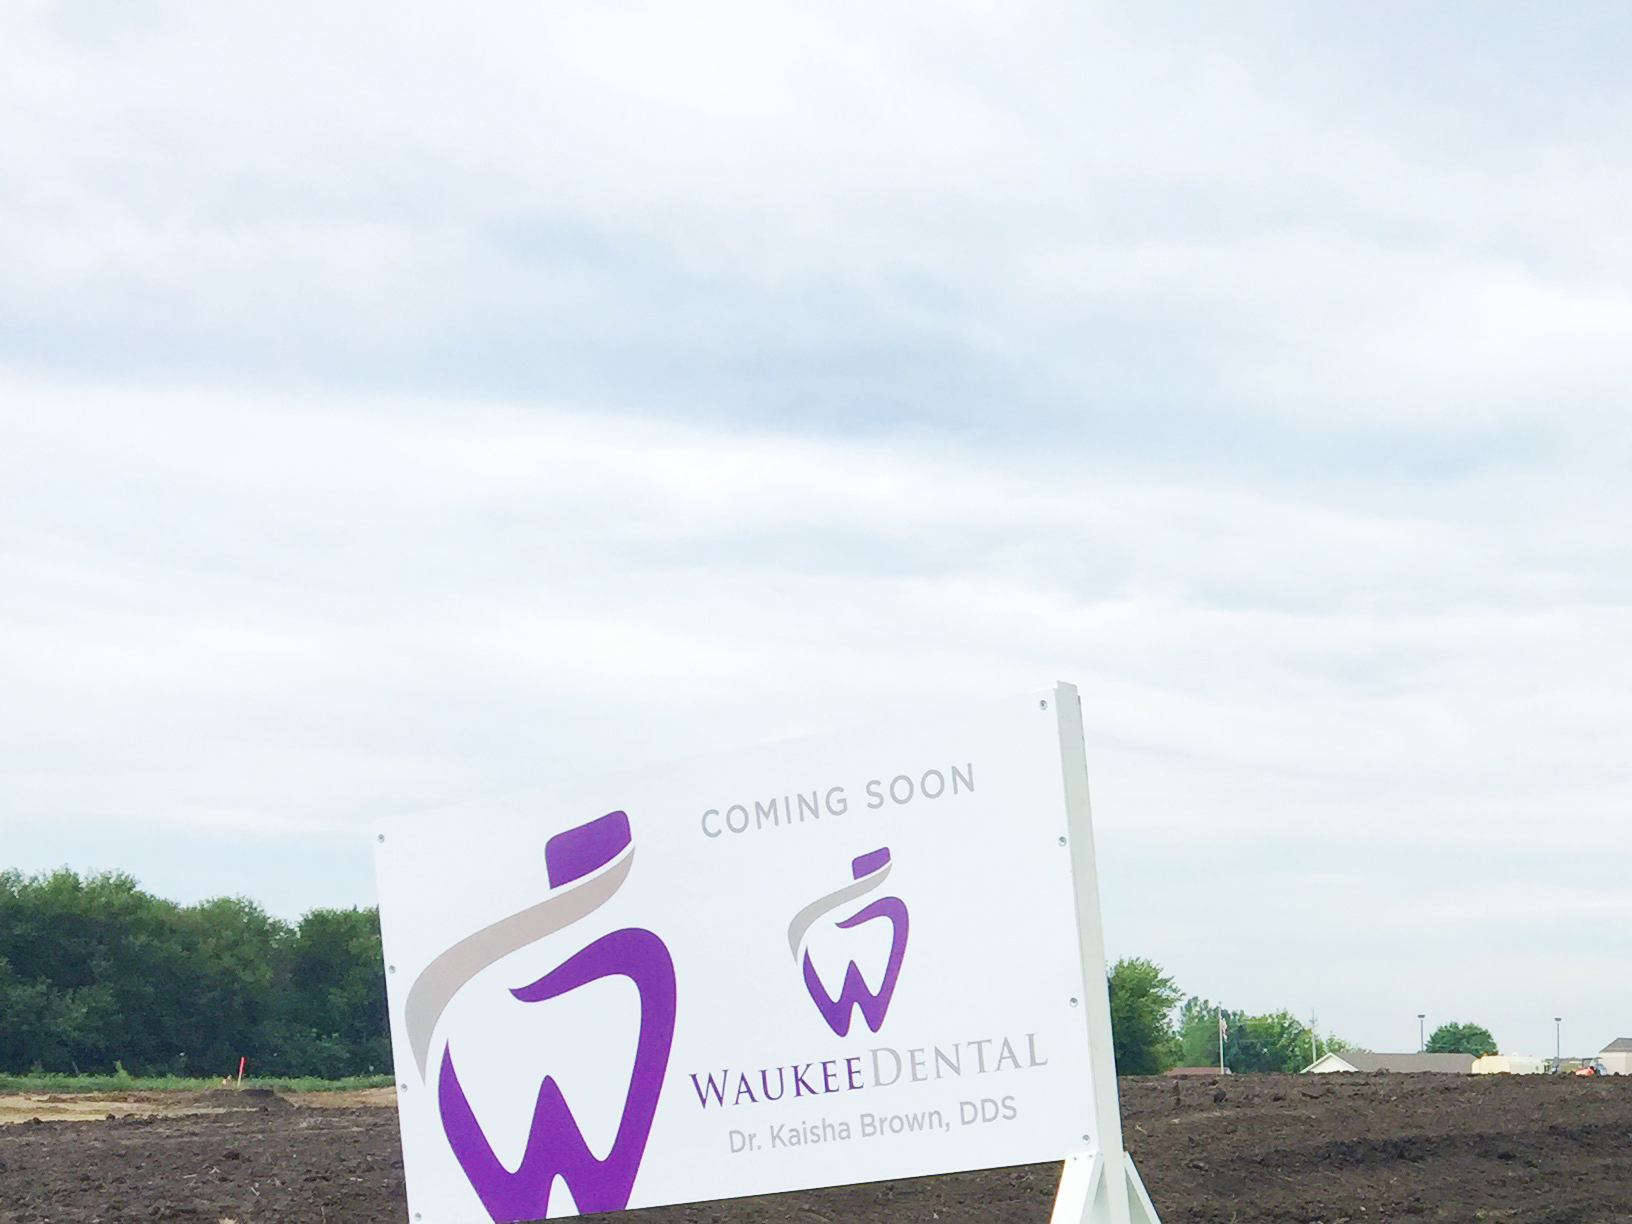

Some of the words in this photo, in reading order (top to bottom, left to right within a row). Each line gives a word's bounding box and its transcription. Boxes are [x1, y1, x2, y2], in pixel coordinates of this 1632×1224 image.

[701, 786, 848, 838] COMING
[865, 763, 975, 809] SOON
[728, 1129, 762, 1154] Dr.
[769, 1117, 852, 1149] Kaisha
[860, 1107, 951, 1138] Brown,
[959, 1095, 1018, 1127] DDS
